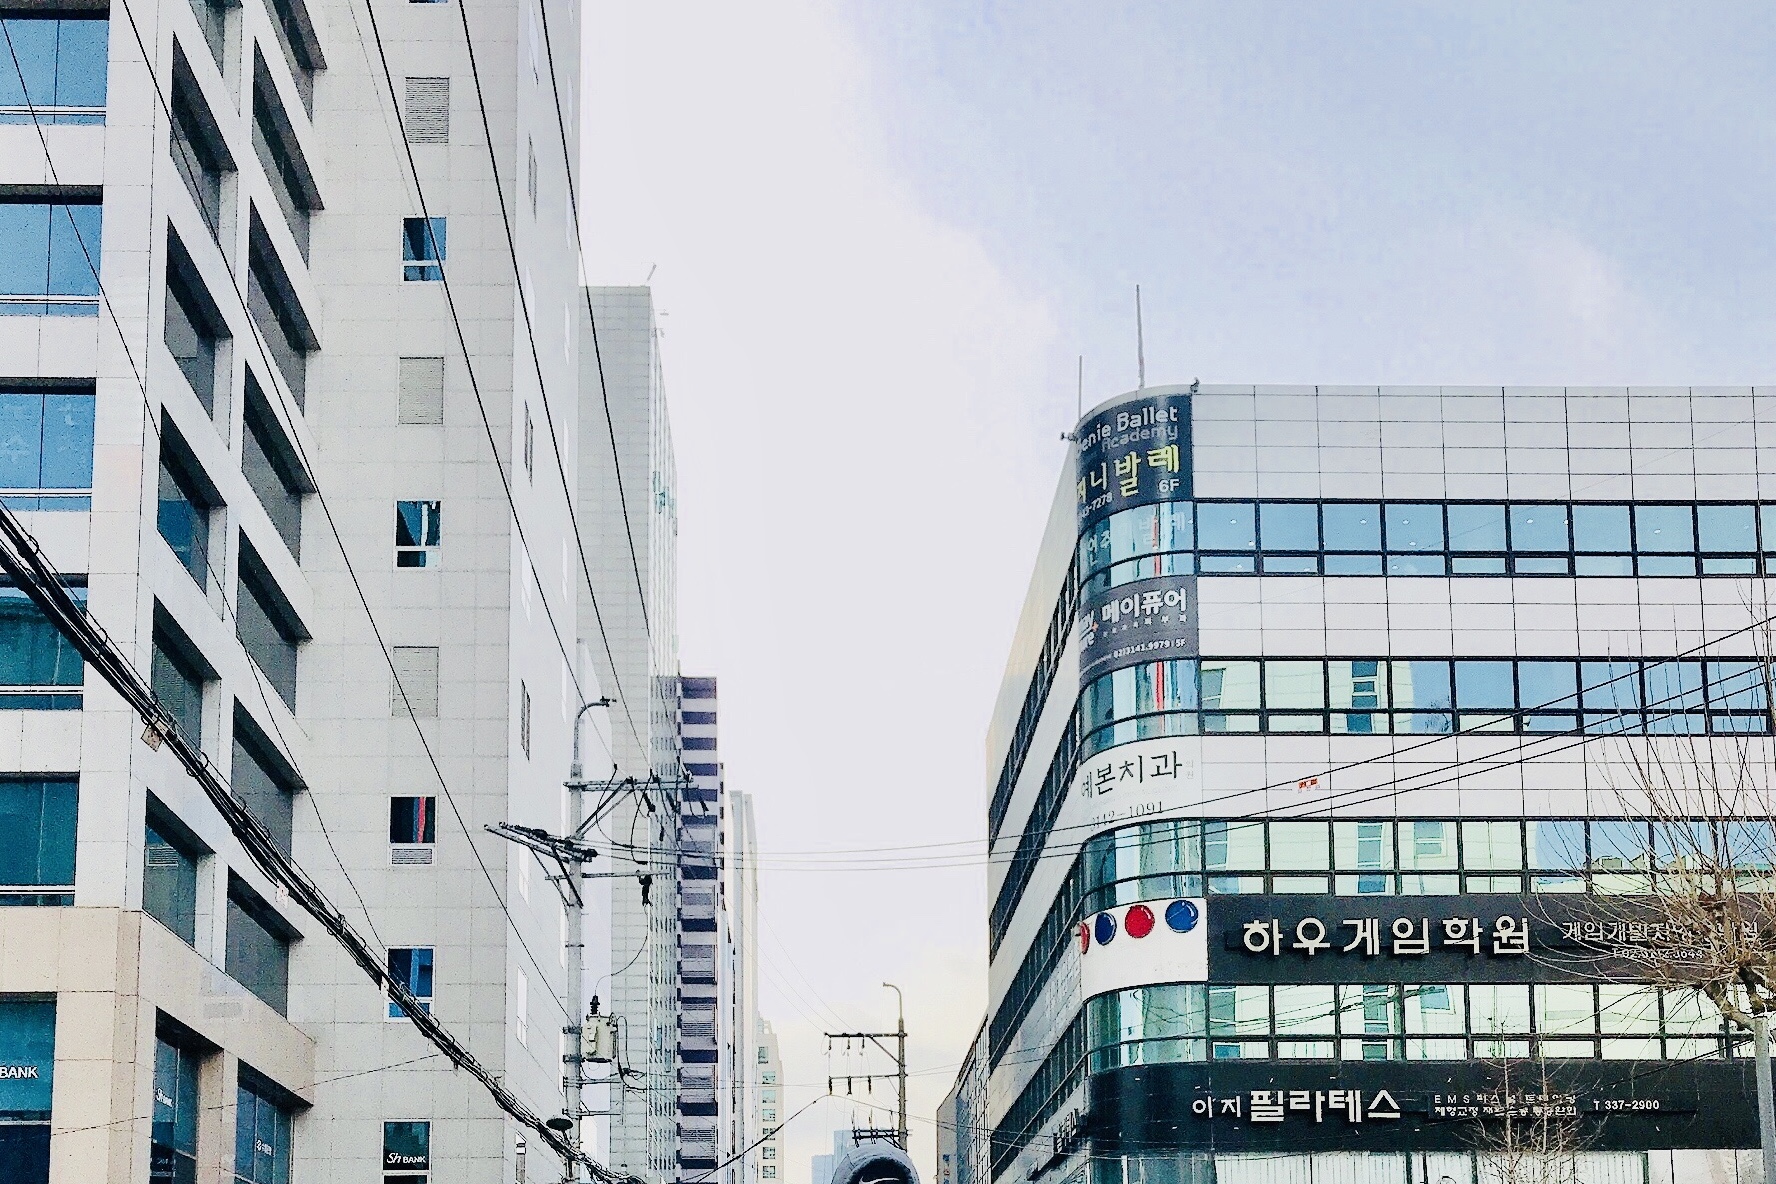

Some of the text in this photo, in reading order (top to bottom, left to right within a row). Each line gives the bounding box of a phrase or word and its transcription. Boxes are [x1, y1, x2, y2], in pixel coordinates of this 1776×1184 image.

[1116, 406, 1178, 432] Ballet
[1159, 478, 1180, 493] 6F
[1101, 587, 1187, 624] 메이퓨어
[1081, 750, 1183, 799] 예본치과
[0, 1066, 39, 1079] BANK
[1192, 1089, 1401, 1123] 이지 필라테스
[1593, 1099, 1660, 1110] T 337-2900
[403, 1156, 427, 1164] BANK
